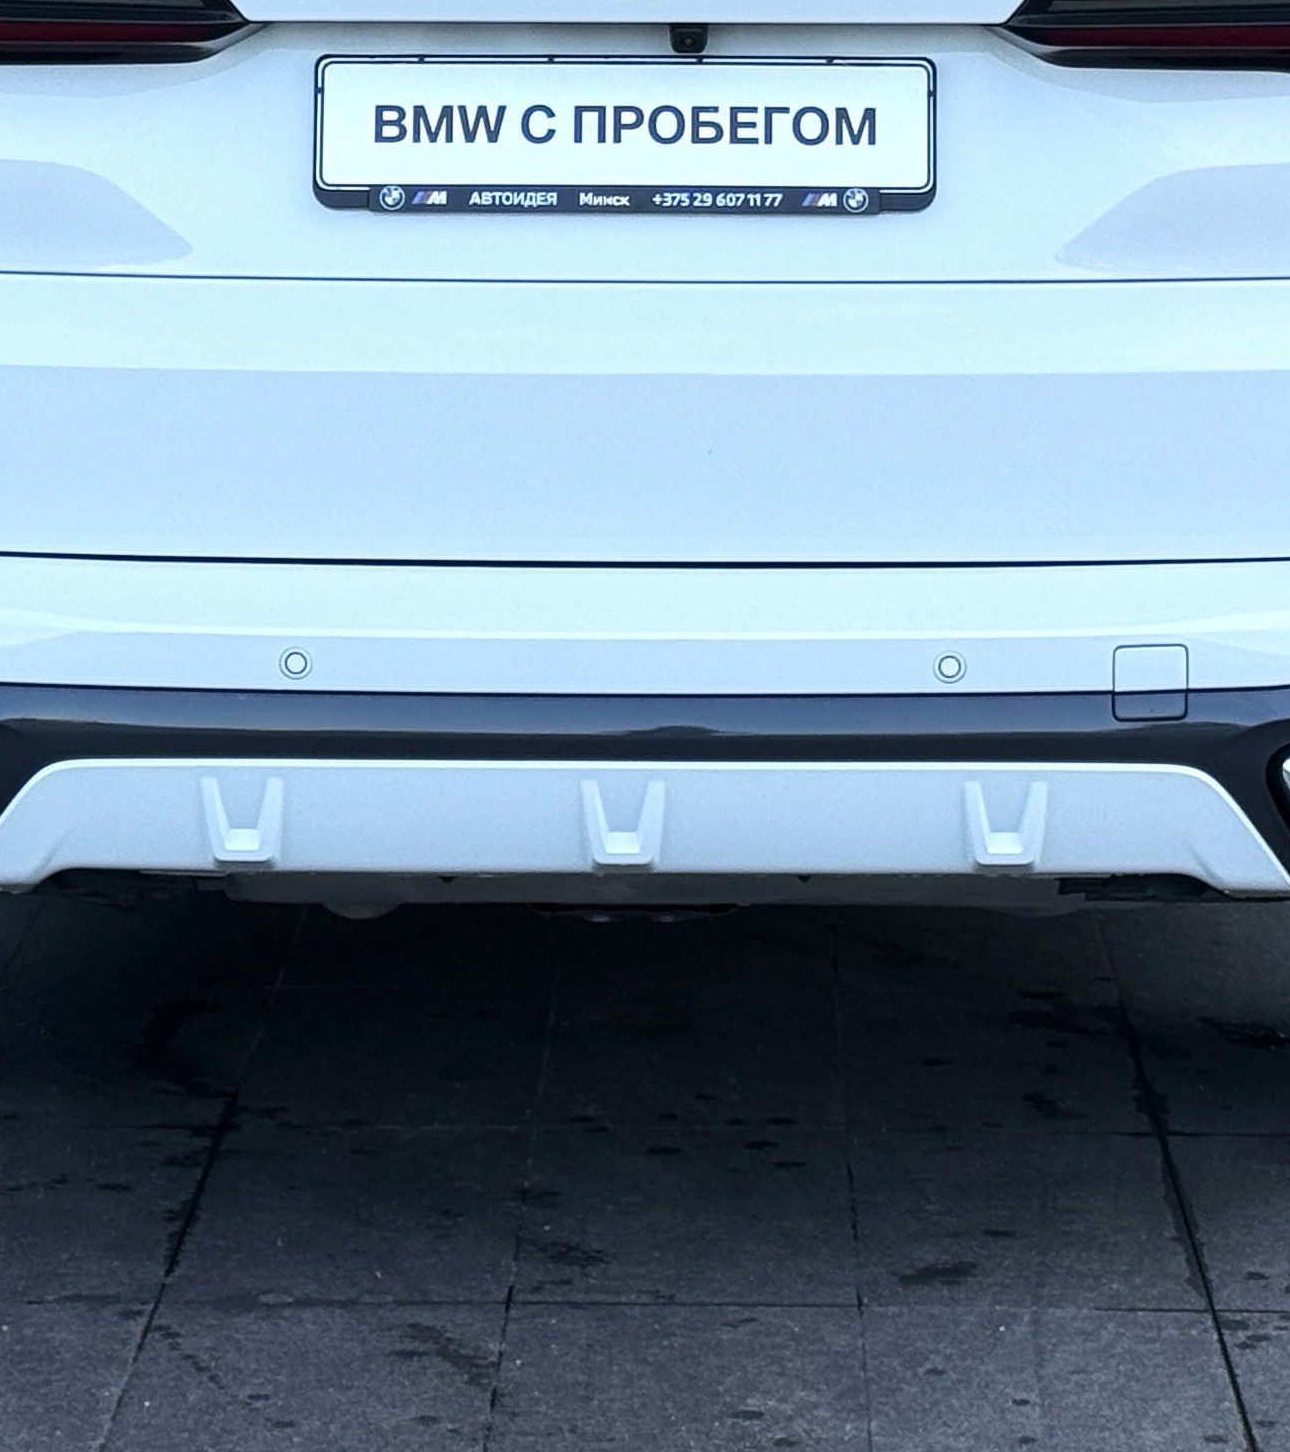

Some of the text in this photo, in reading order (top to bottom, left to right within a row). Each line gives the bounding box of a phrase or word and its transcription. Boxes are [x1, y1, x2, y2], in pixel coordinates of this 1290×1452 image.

[374, 105, 877, 146] BMW С ПРОБЕГОМ
[469, 192, 558, 208] АВТОИДЕЯ
[653, 193, 690, 207] +375
[693, 193, 713, 207] 29
[716, 193, 748, 207] 607
[747, 193, 761, 207] 11
[763, 193, 783, 208] 77
